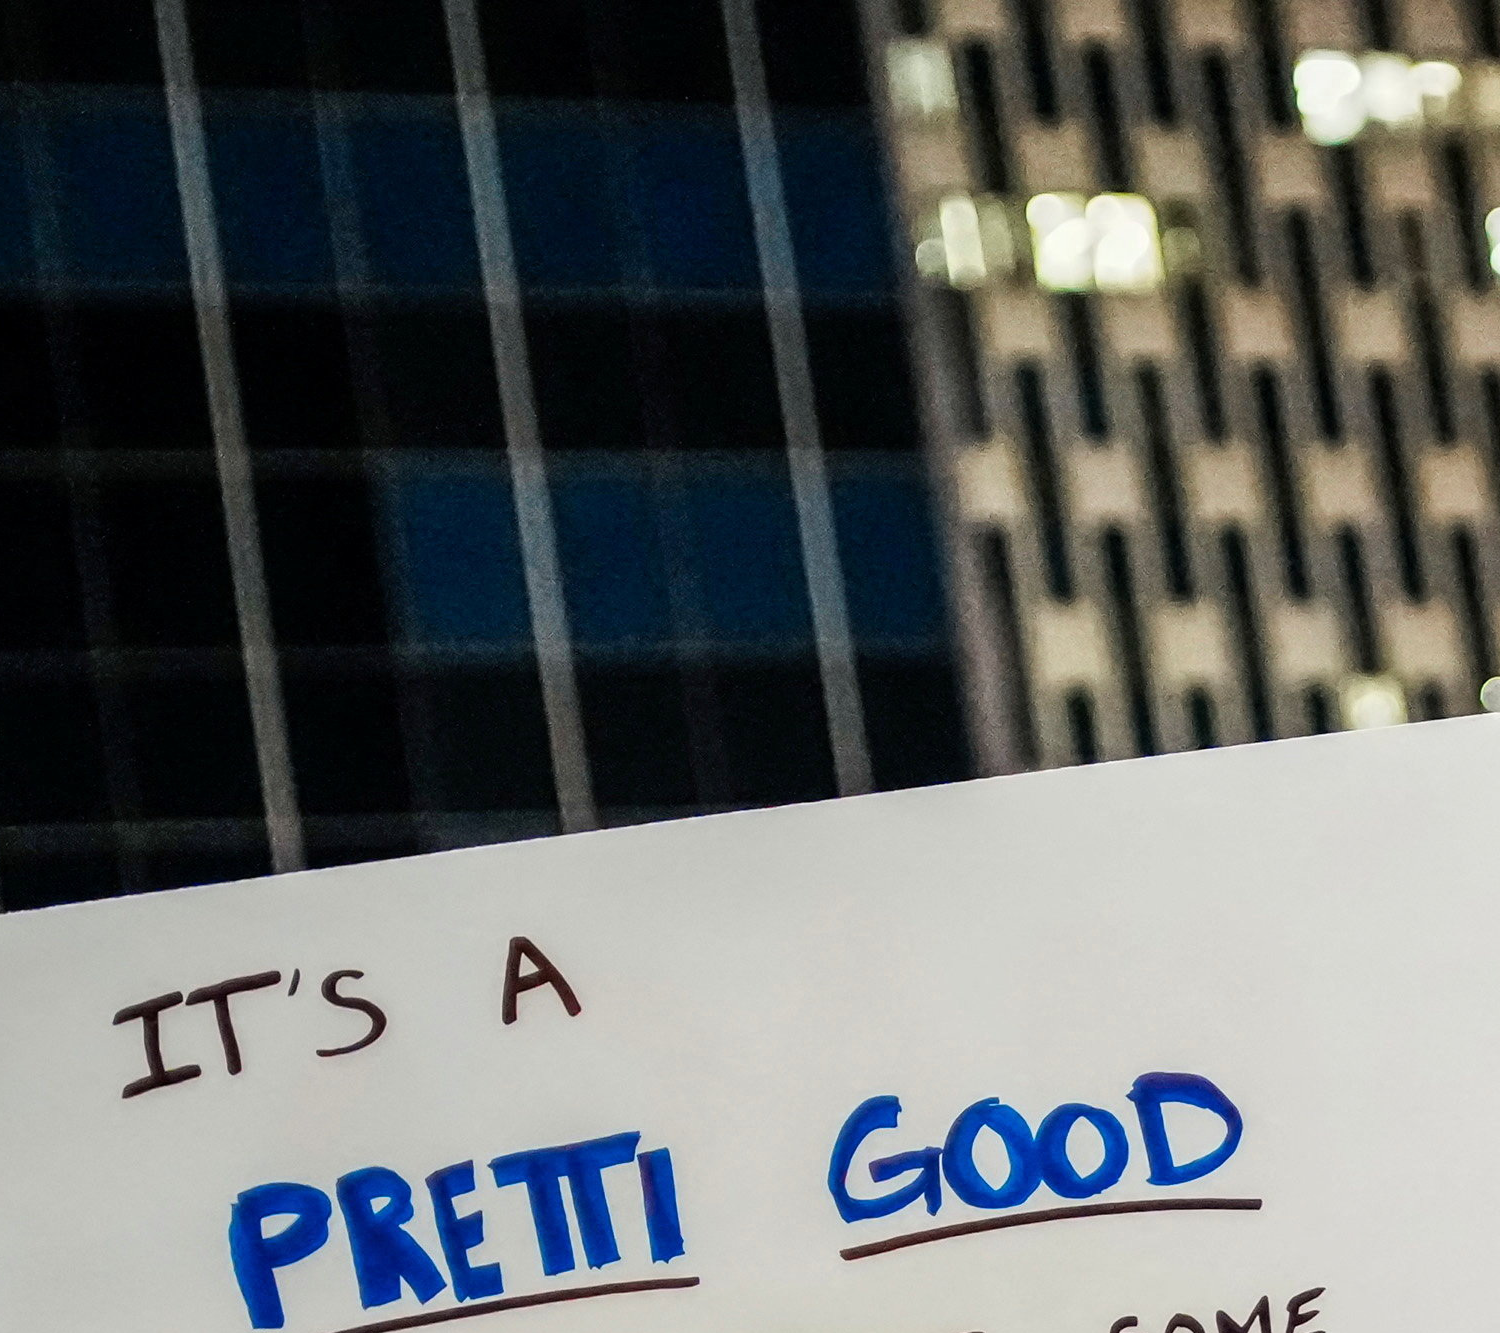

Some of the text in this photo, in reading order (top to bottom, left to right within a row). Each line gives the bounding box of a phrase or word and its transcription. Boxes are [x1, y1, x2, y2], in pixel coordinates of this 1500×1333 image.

[111, 936, 583, 1100] IT'S A
[227, 1071, 1244, 1331] PRETTI GOOD
